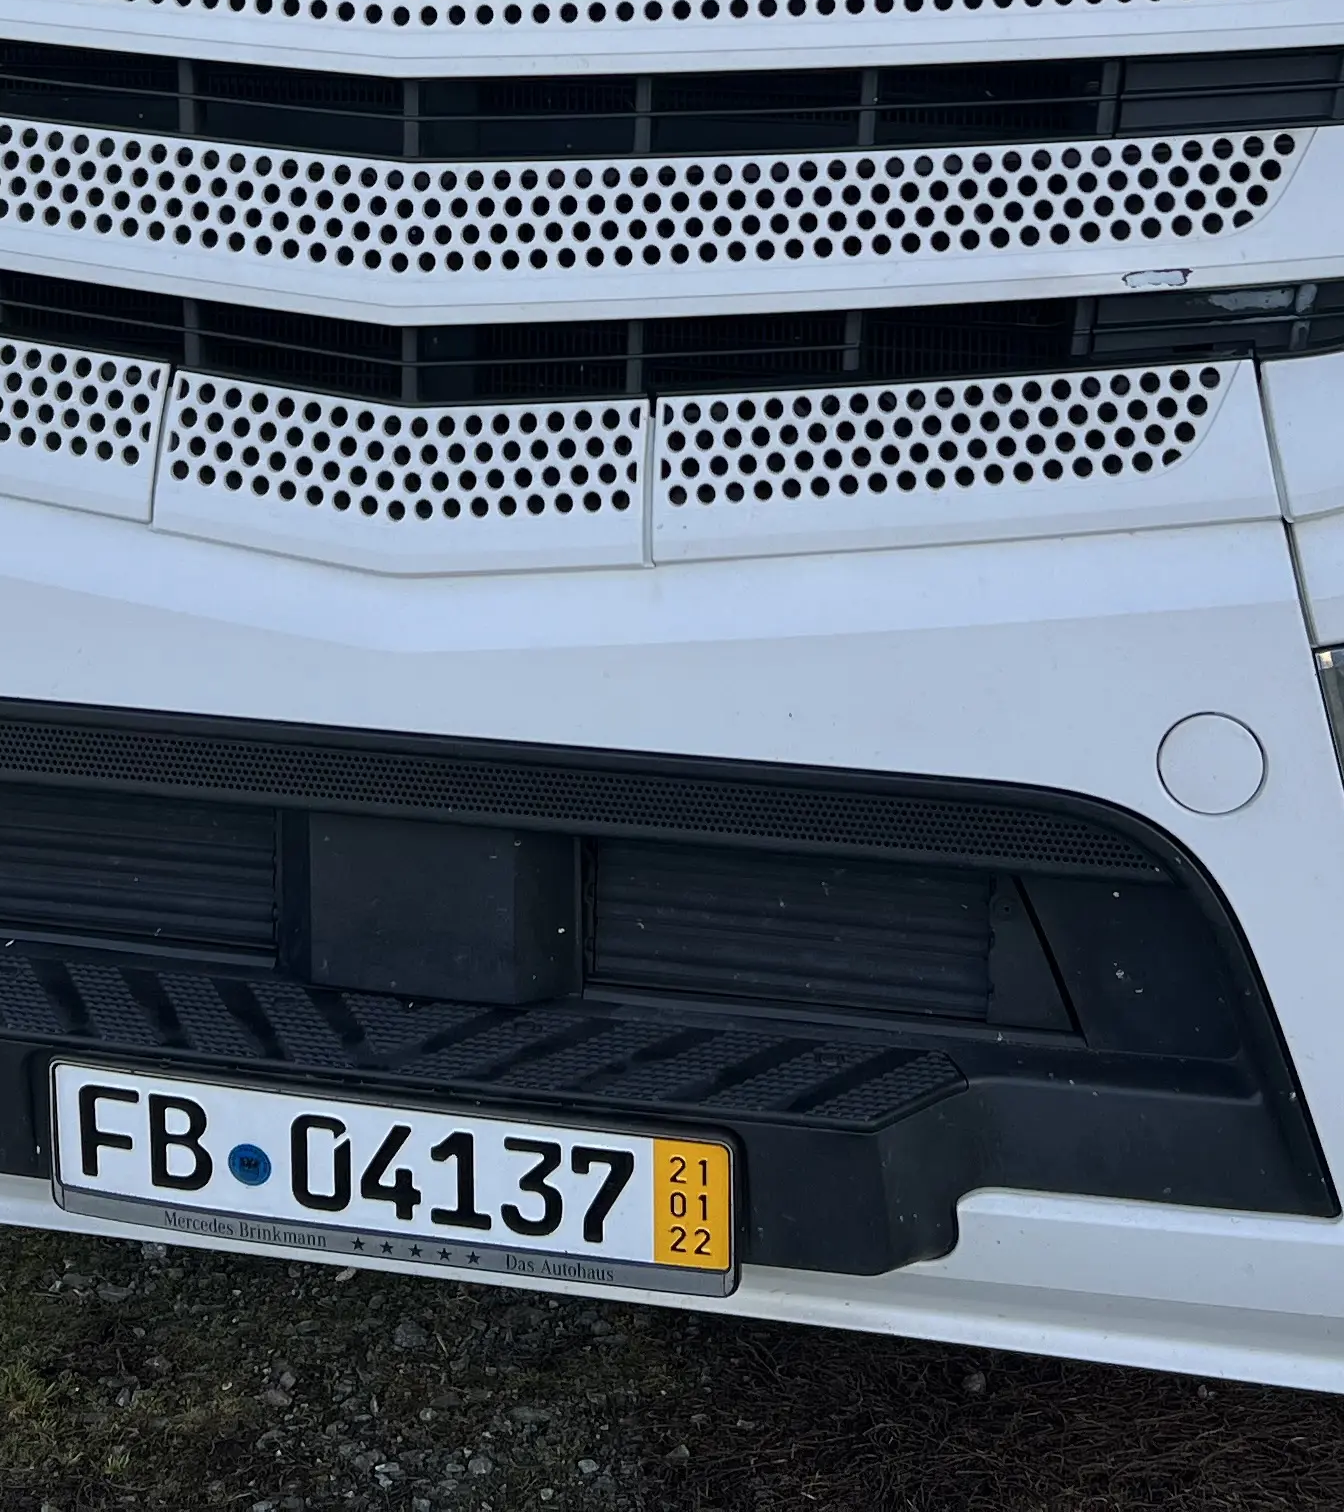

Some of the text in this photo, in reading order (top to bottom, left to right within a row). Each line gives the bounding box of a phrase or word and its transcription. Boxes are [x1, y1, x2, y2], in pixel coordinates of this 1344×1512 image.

[79, 1084, 634, 1243] FB 04137
[669, 1156, 708, 1186] 21
[669, 1192, 708, 1220] 01
[164, 1211, 327, 1248] Mercedes Brinkmann
[669, 1226, 711, 1255] 22
[505, 1254, 614, 1281] Das Autohaus
